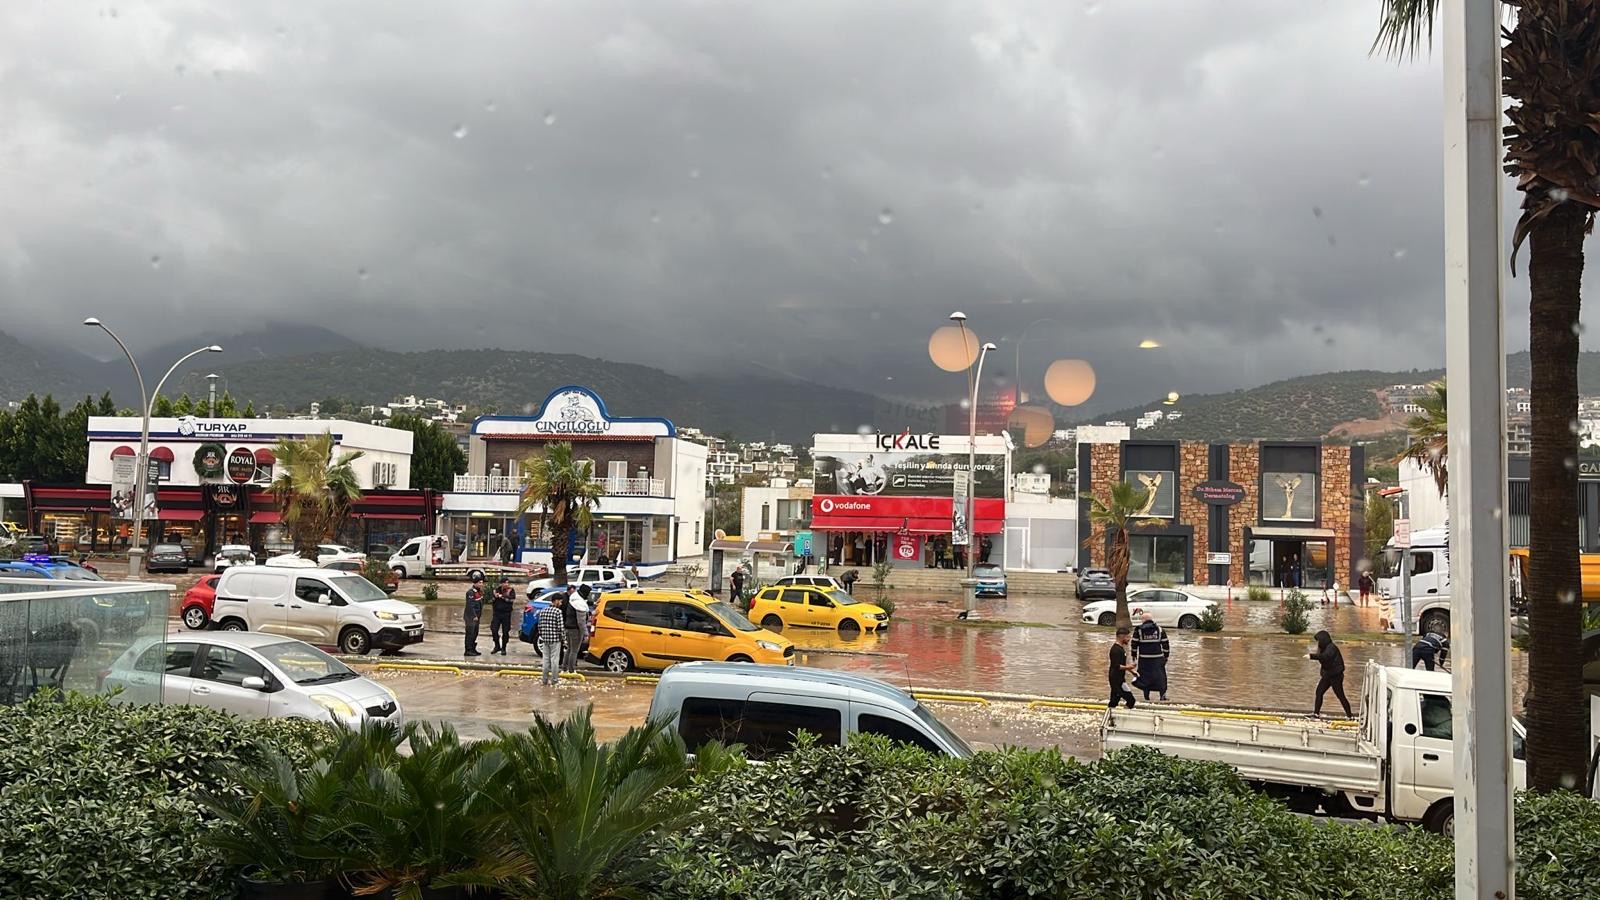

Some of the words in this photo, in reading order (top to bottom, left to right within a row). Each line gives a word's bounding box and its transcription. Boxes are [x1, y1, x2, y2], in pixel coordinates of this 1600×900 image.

[196, 423, 247, 432] TURYAP
[875, 430, 940, 452] İÇKALE
[230, 456, 253, 465] ROYAL
[1580, 463, 1600, 472] GA
[834, 502, 871, 510] vodafone
